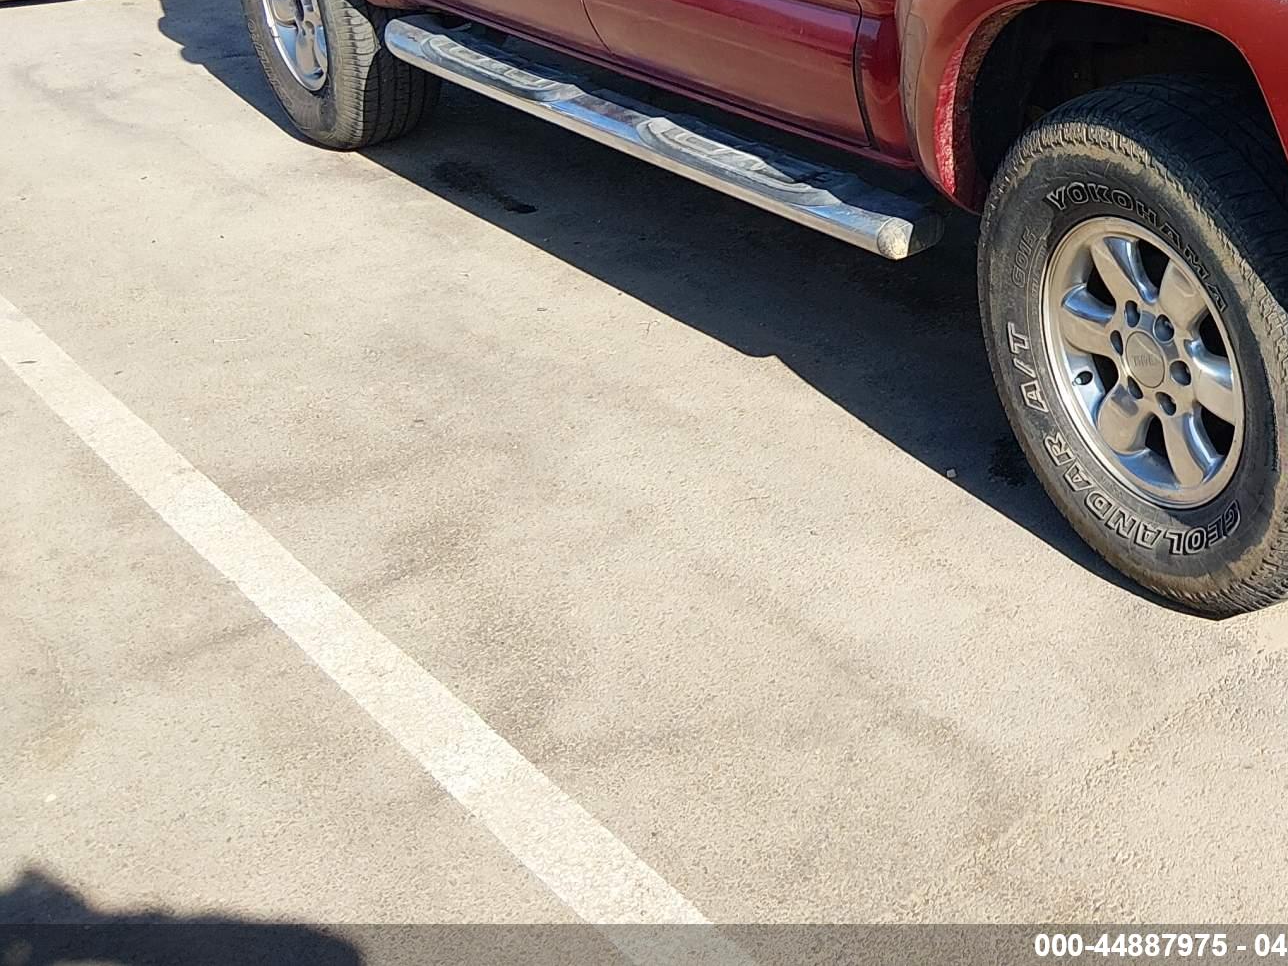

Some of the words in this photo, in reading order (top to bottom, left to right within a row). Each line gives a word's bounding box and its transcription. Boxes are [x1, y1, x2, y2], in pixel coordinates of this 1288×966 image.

[1045, 181, 1228, 313] YOKOHAMA
[1007, 321, 1049, 413] A/T
[1043, 432, 1241, 555] GEOLANDAR
